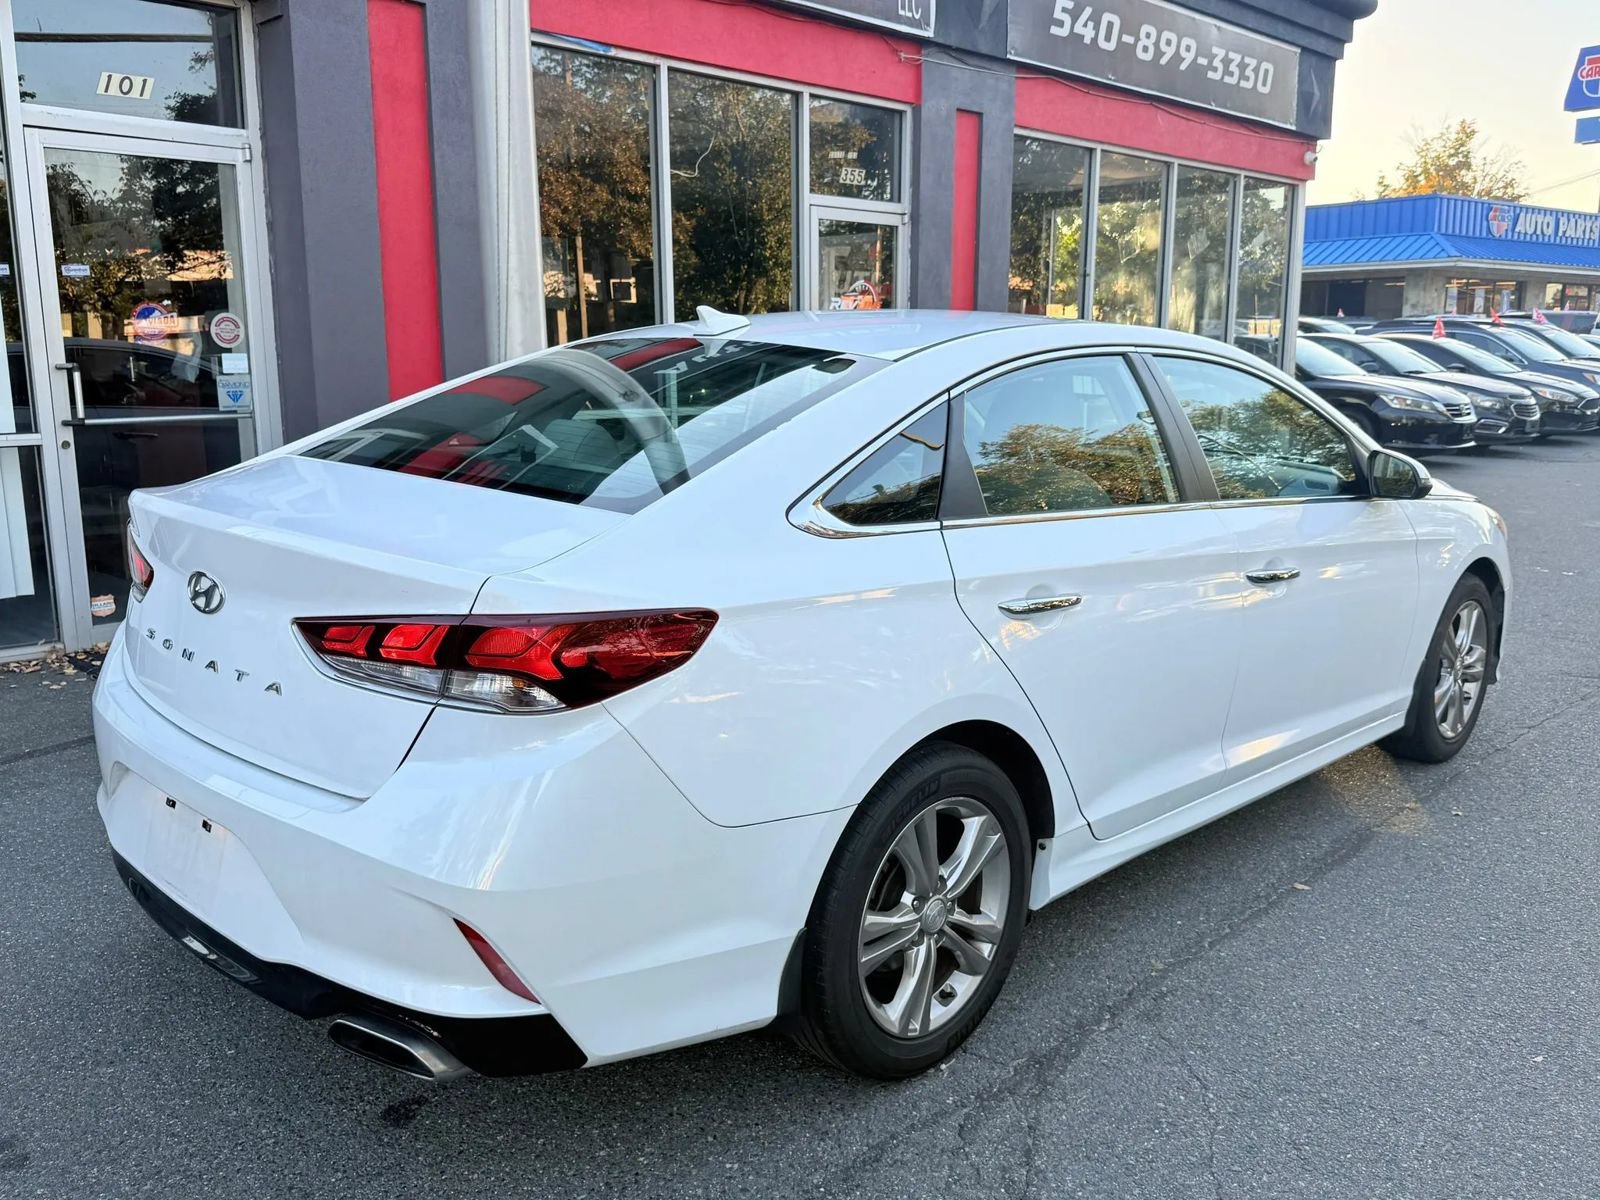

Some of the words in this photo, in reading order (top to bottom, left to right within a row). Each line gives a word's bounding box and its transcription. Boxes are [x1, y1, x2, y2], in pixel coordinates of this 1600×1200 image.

[1049, 0, 1275, 95] 540-899-3330
[103, 73, 148, 98] 101
[841, 168, 864, 184] 355
[1515, 213, 1553, 237] AUTO
[1558, 216, 1600, 240] PARTS
[145, 627, 283, 697] SONATA
